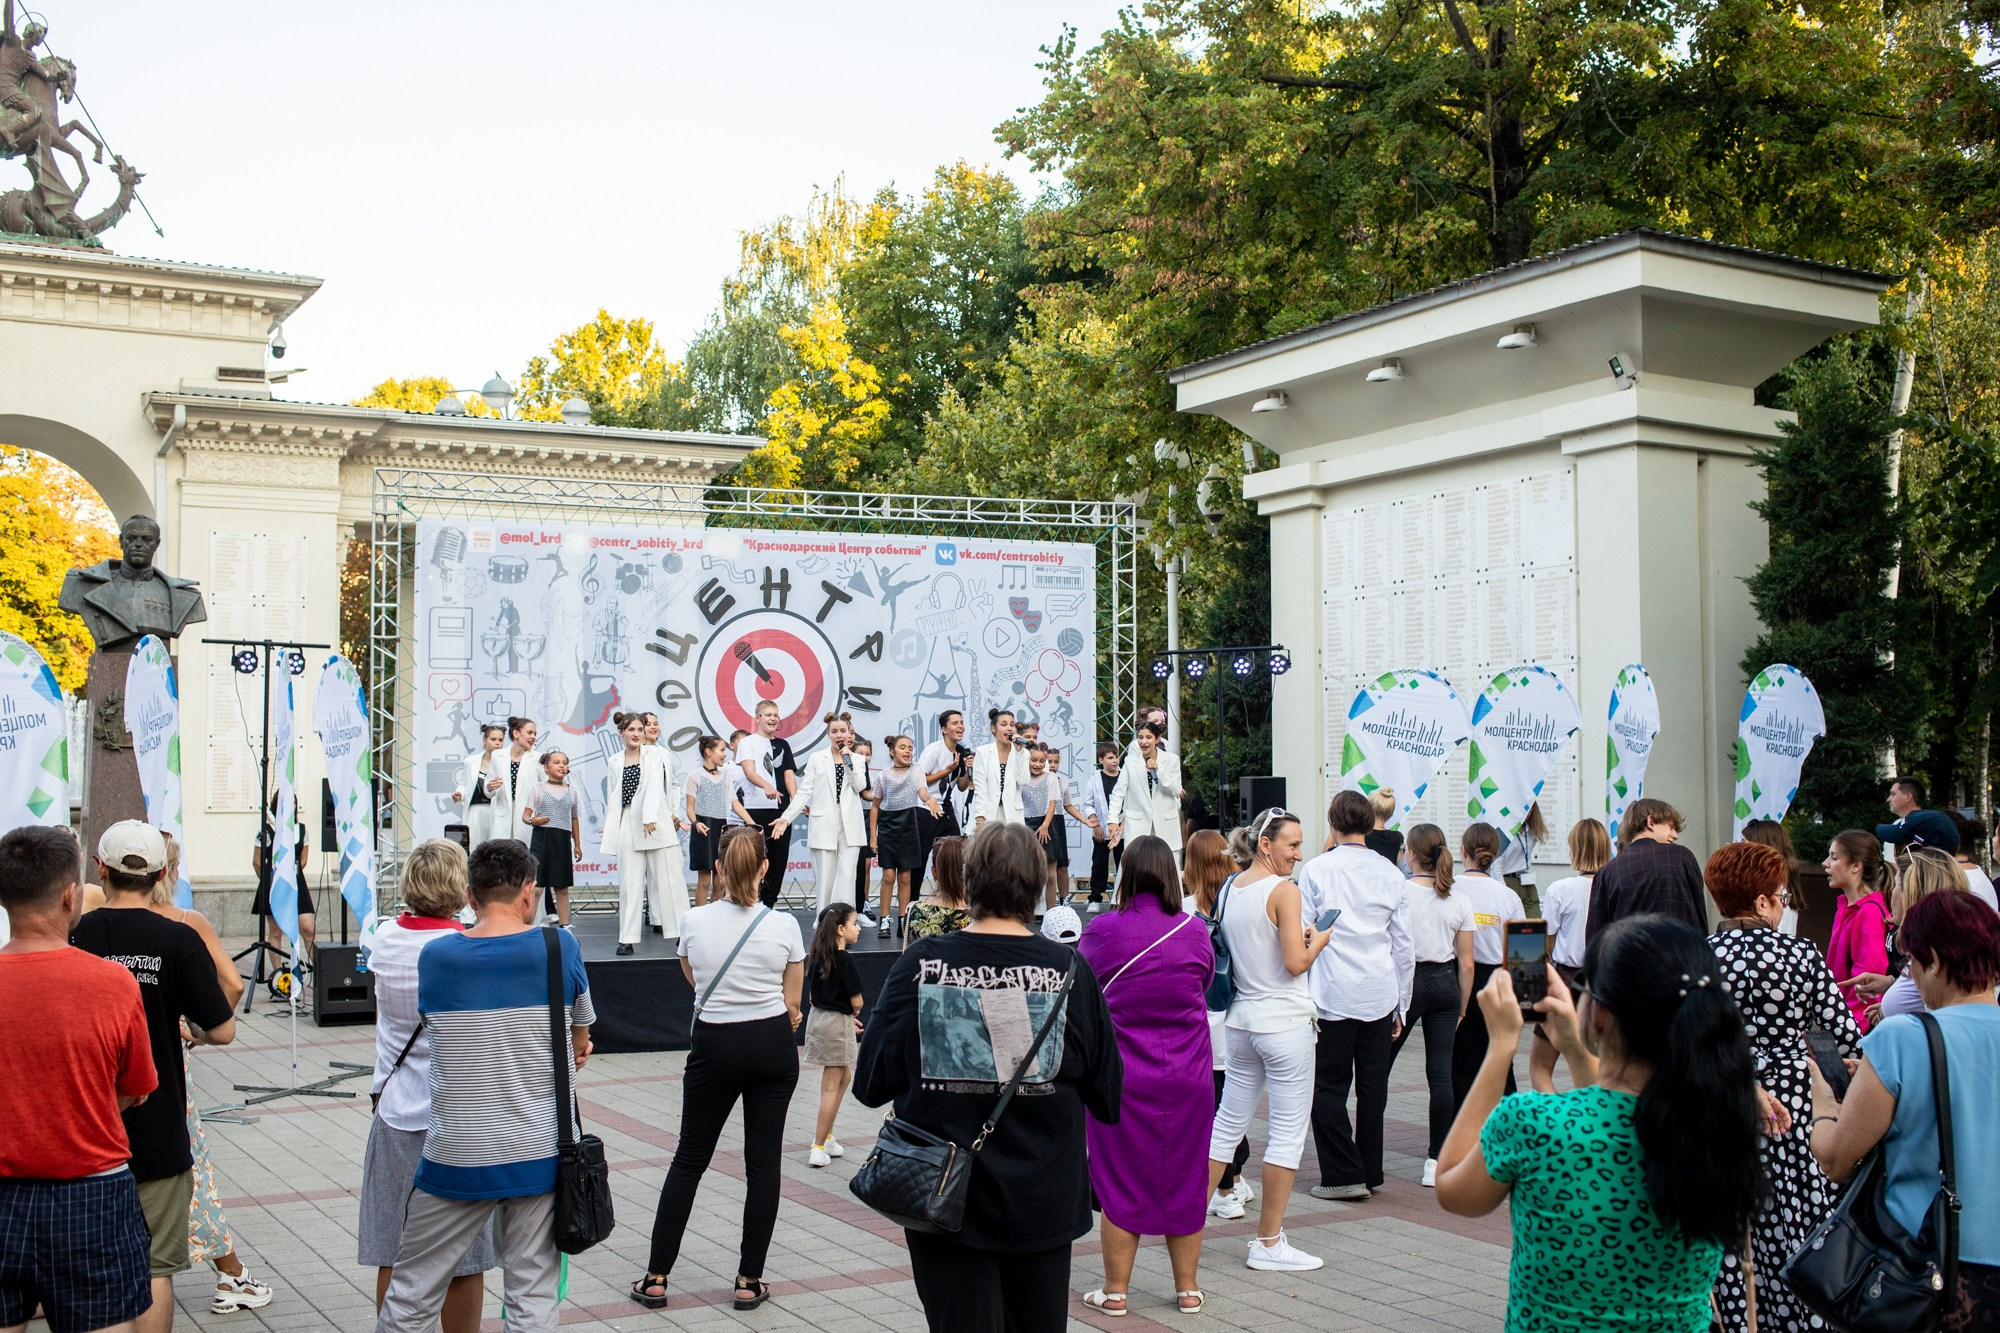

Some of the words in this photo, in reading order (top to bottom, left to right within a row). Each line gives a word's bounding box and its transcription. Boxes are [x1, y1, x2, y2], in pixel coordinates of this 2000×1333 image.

[500, 532, 562, 546] @mol_krd
[588, 536, 704, 552] @centr_sobitiy_krd
[743, 538, 836, 554] "Краснодарский
[838, 542, 873, 557] Центр
[874, 543, 927, 556] событий"
[959, 548, 1065, 566] vk.com/centrsobitiy
[1361, 722, 1417, 742] МОЛЦЕНТР
[1484, 726, 1533, 740] МОЛЦЕНТР
[1750, 724, 1787, 742] МОЛЦЕНТР
[1386, 738, 1445, 758] КРАСНОДАР
[1507, 739, 1559, 754] КРАСНОДАР
[1765, 741, 1805, 759] КРАСНОДАР
